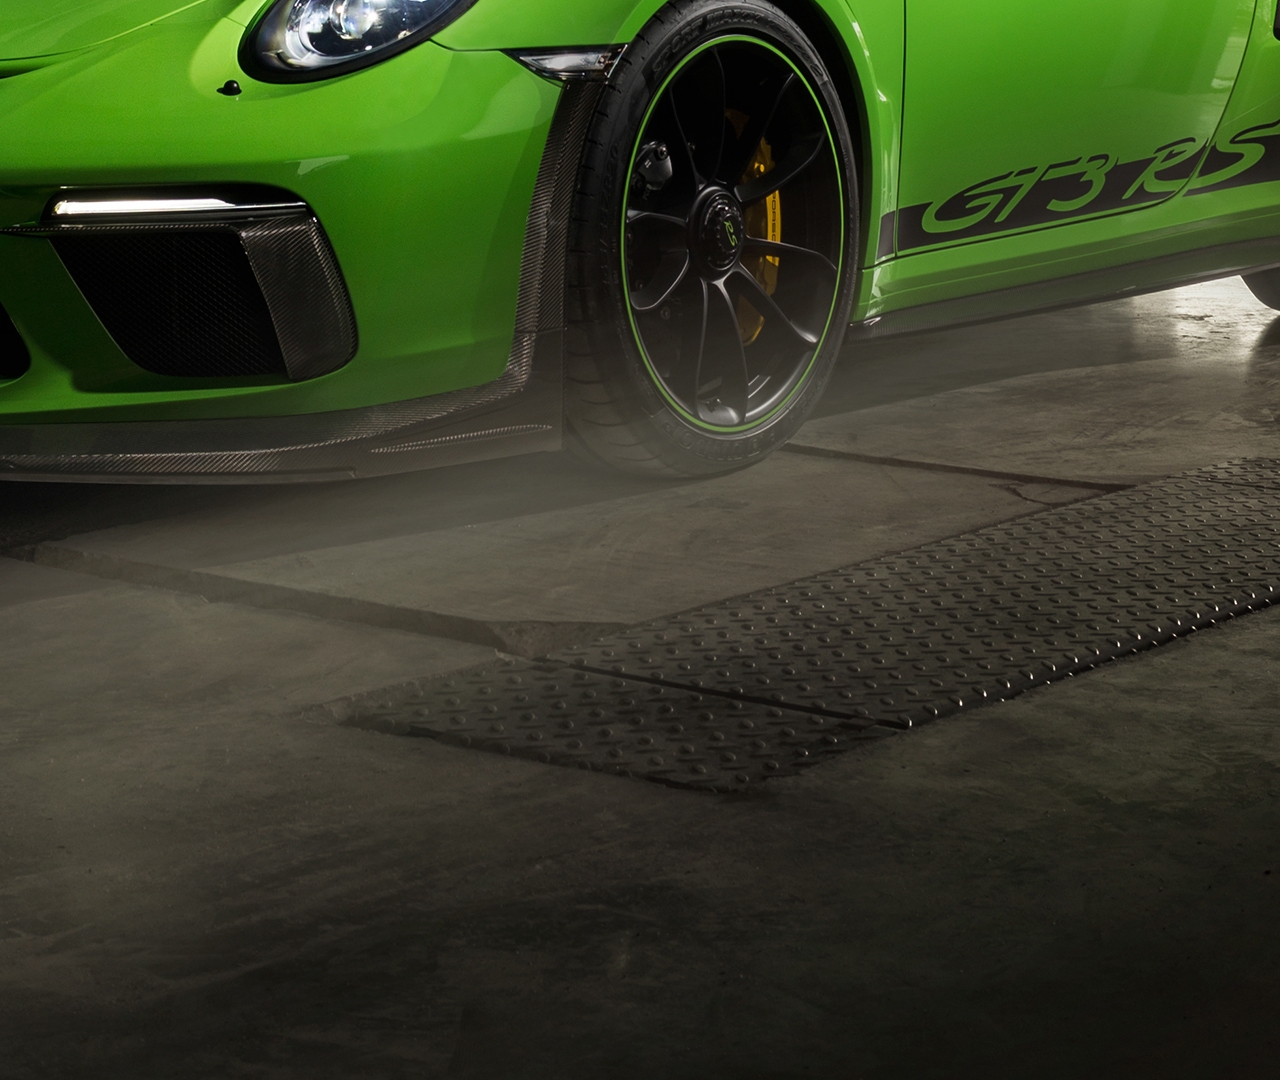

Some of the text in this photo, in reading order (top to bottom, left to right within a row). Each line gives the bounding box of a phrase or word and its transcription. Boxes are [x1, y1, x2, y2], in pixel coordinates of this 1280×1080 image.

[652, 17, 704, 82] SPORT
[705, 8, 765, 30] MAXX
[921, 152, 1120, 234] GT3
[723, 220, 739, 247] RS
